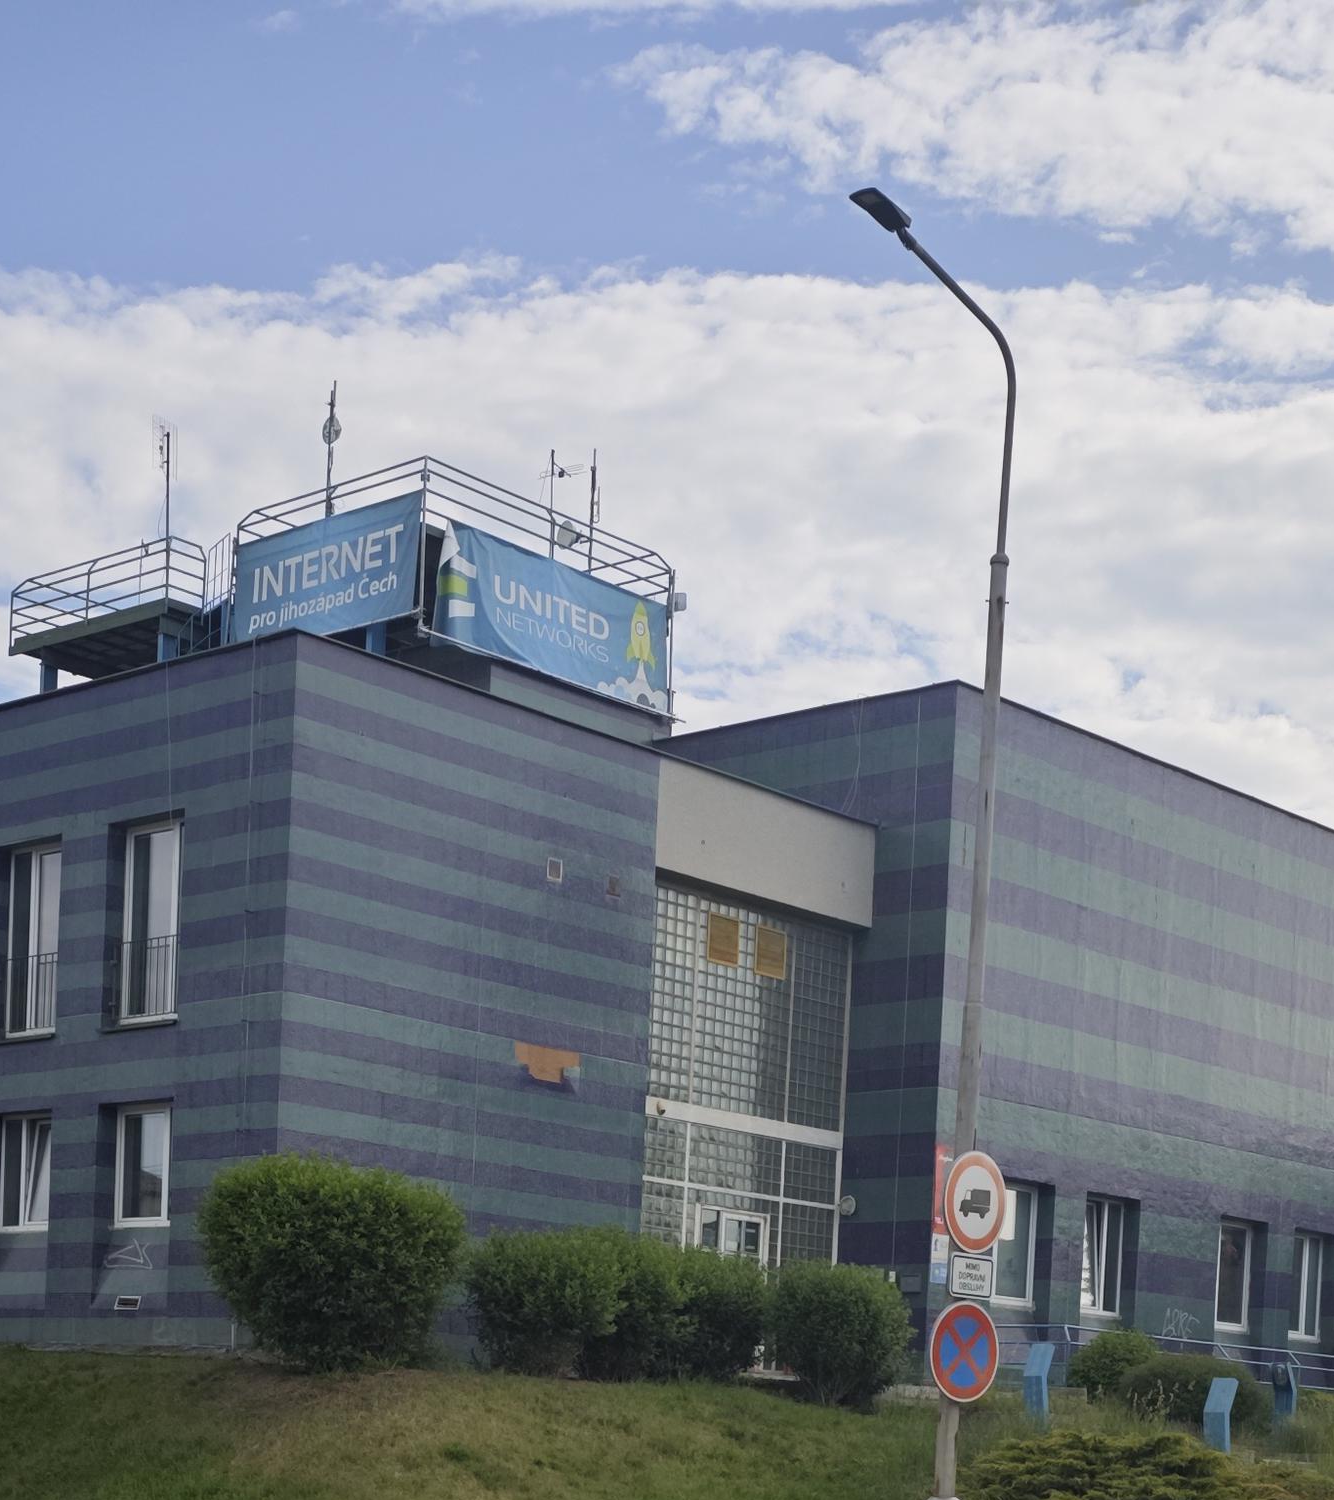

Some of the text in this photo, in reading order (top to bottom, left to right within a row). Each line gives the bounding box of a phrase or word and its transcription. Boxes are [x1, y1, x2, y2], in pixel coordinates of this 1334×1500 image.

[252, 523, 404, 604] INTERNET
[248, 571, 398, 634] pro jihozápad Čech
[494, 575, 610, 641] UNITED
[496, 607, 610, 663] NETWORKS
